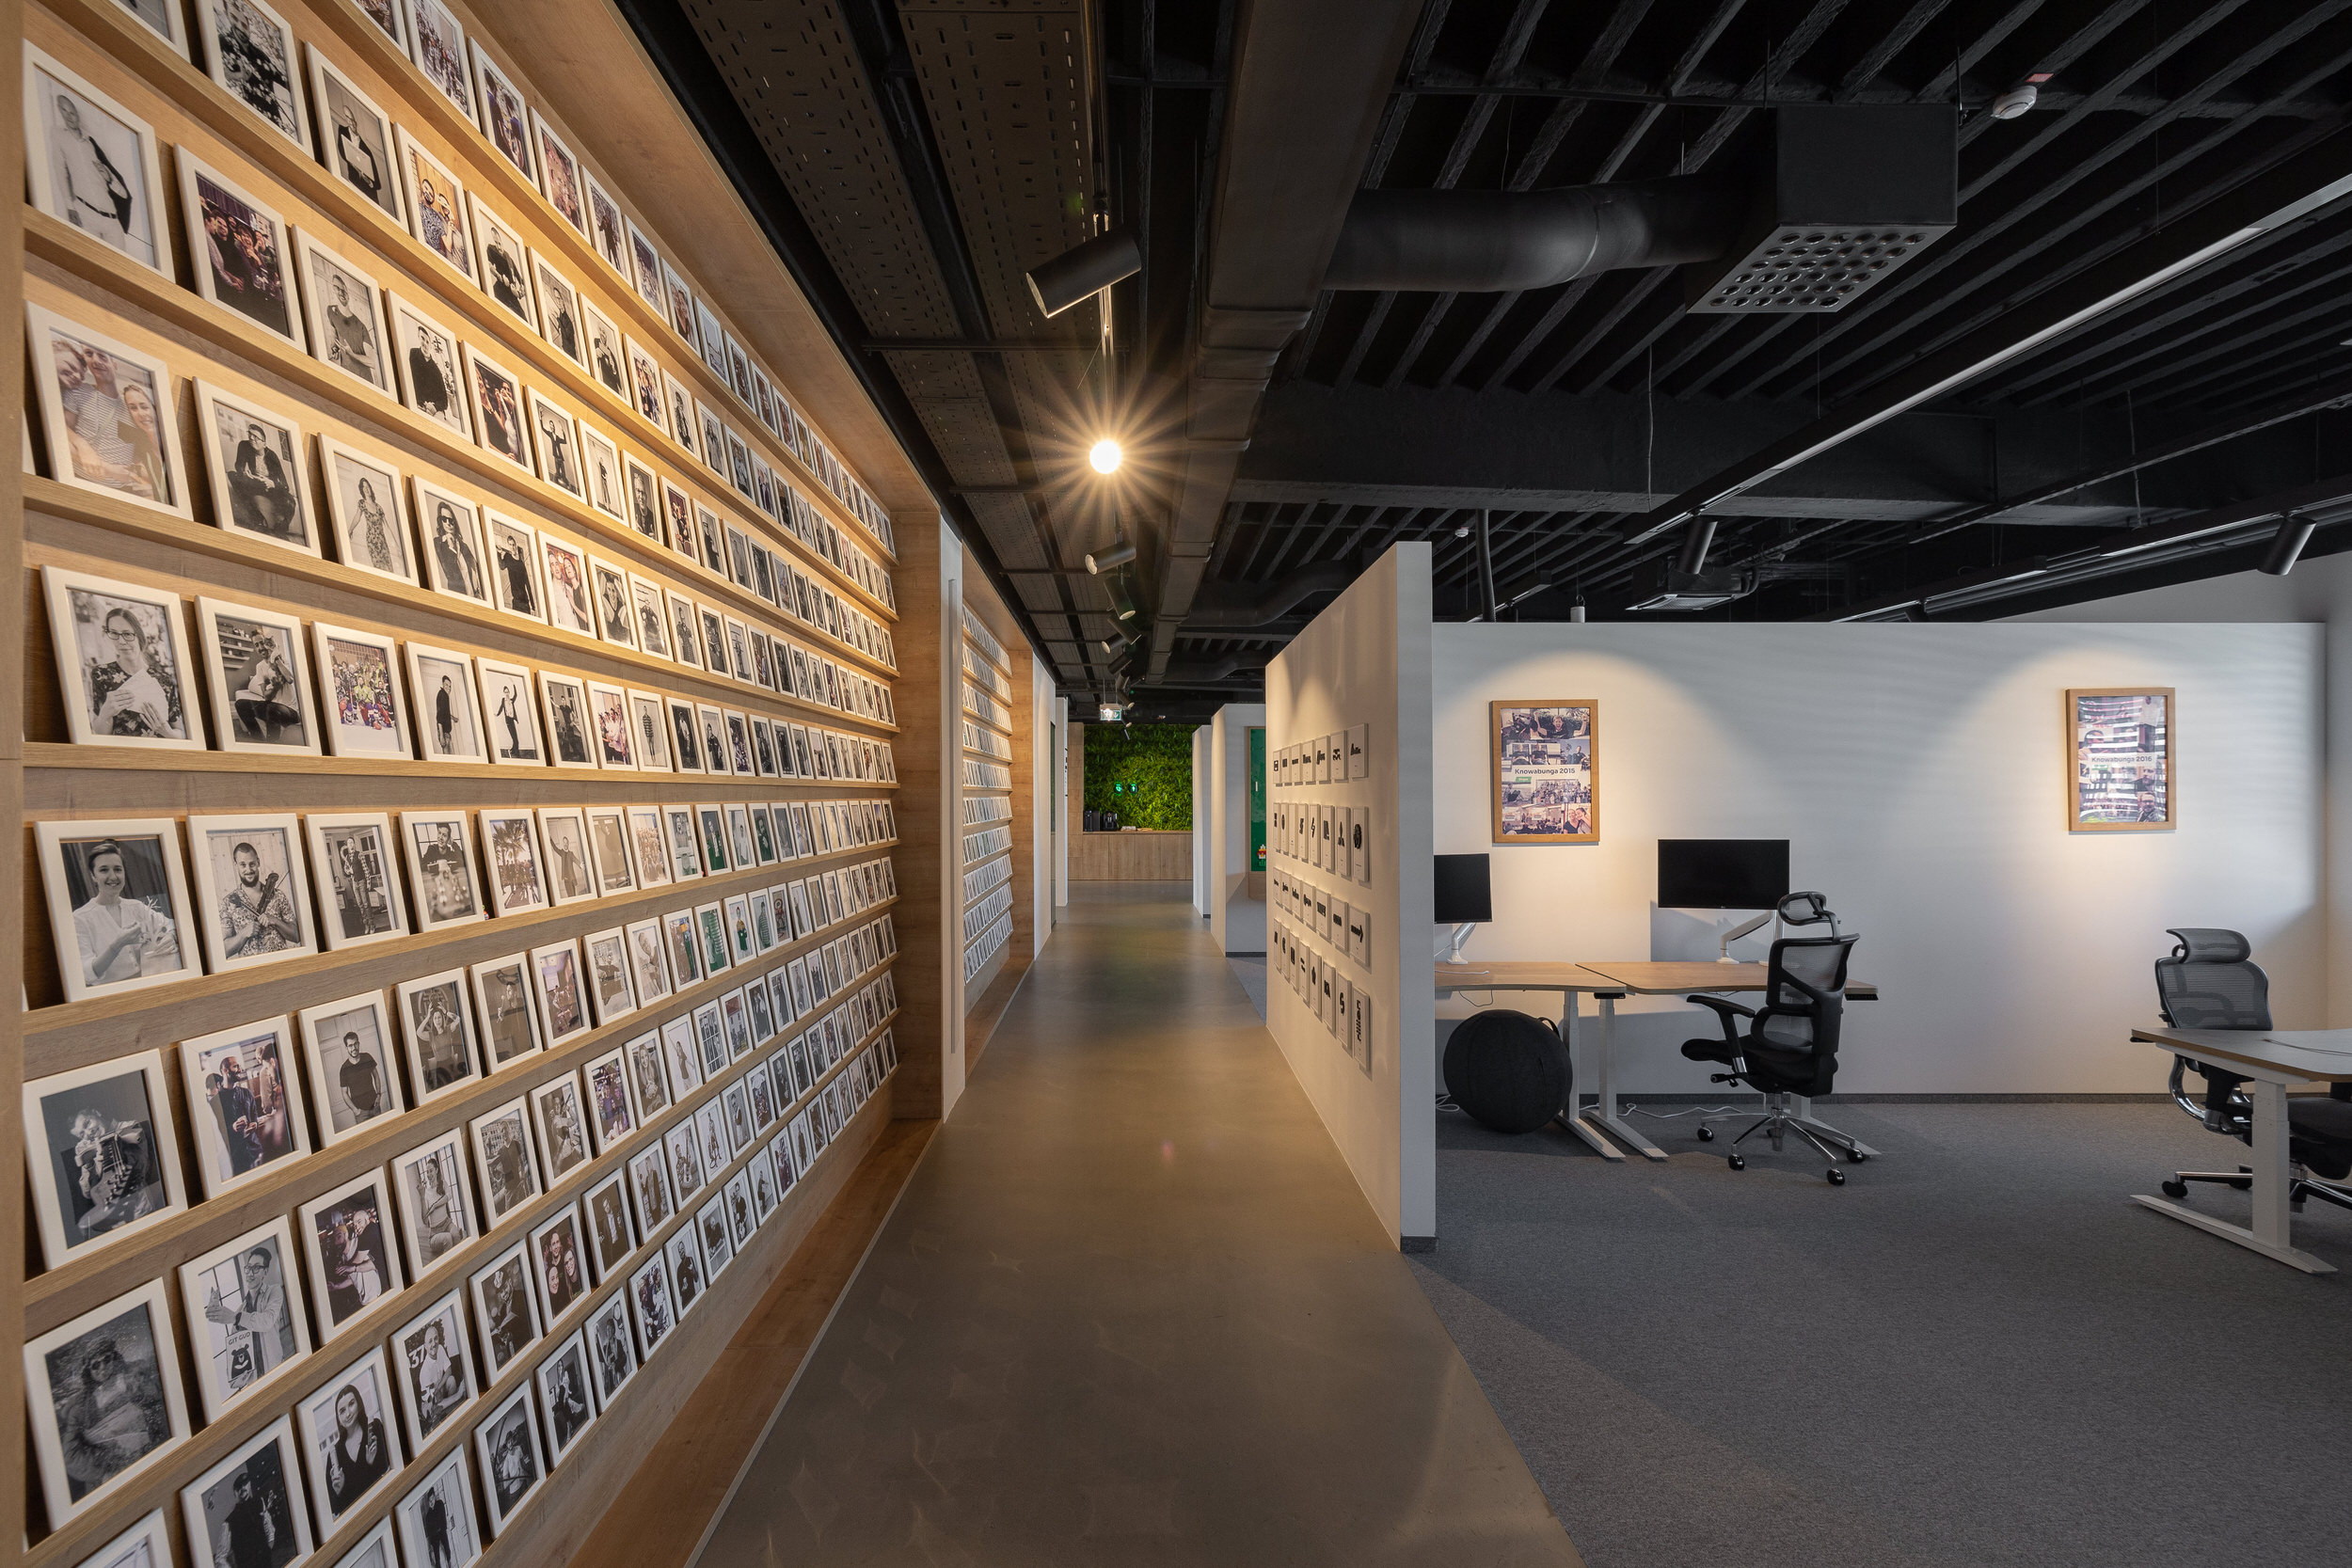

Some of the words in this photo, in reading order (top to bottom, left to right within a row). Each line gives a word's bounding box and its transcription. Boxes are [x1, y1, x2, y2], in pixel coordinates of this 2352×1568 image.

[229, 1337, 238, 1345] GIT
[238, 1332, 250, 1340] GUD
[408, 1345, 425, 1368] 37
